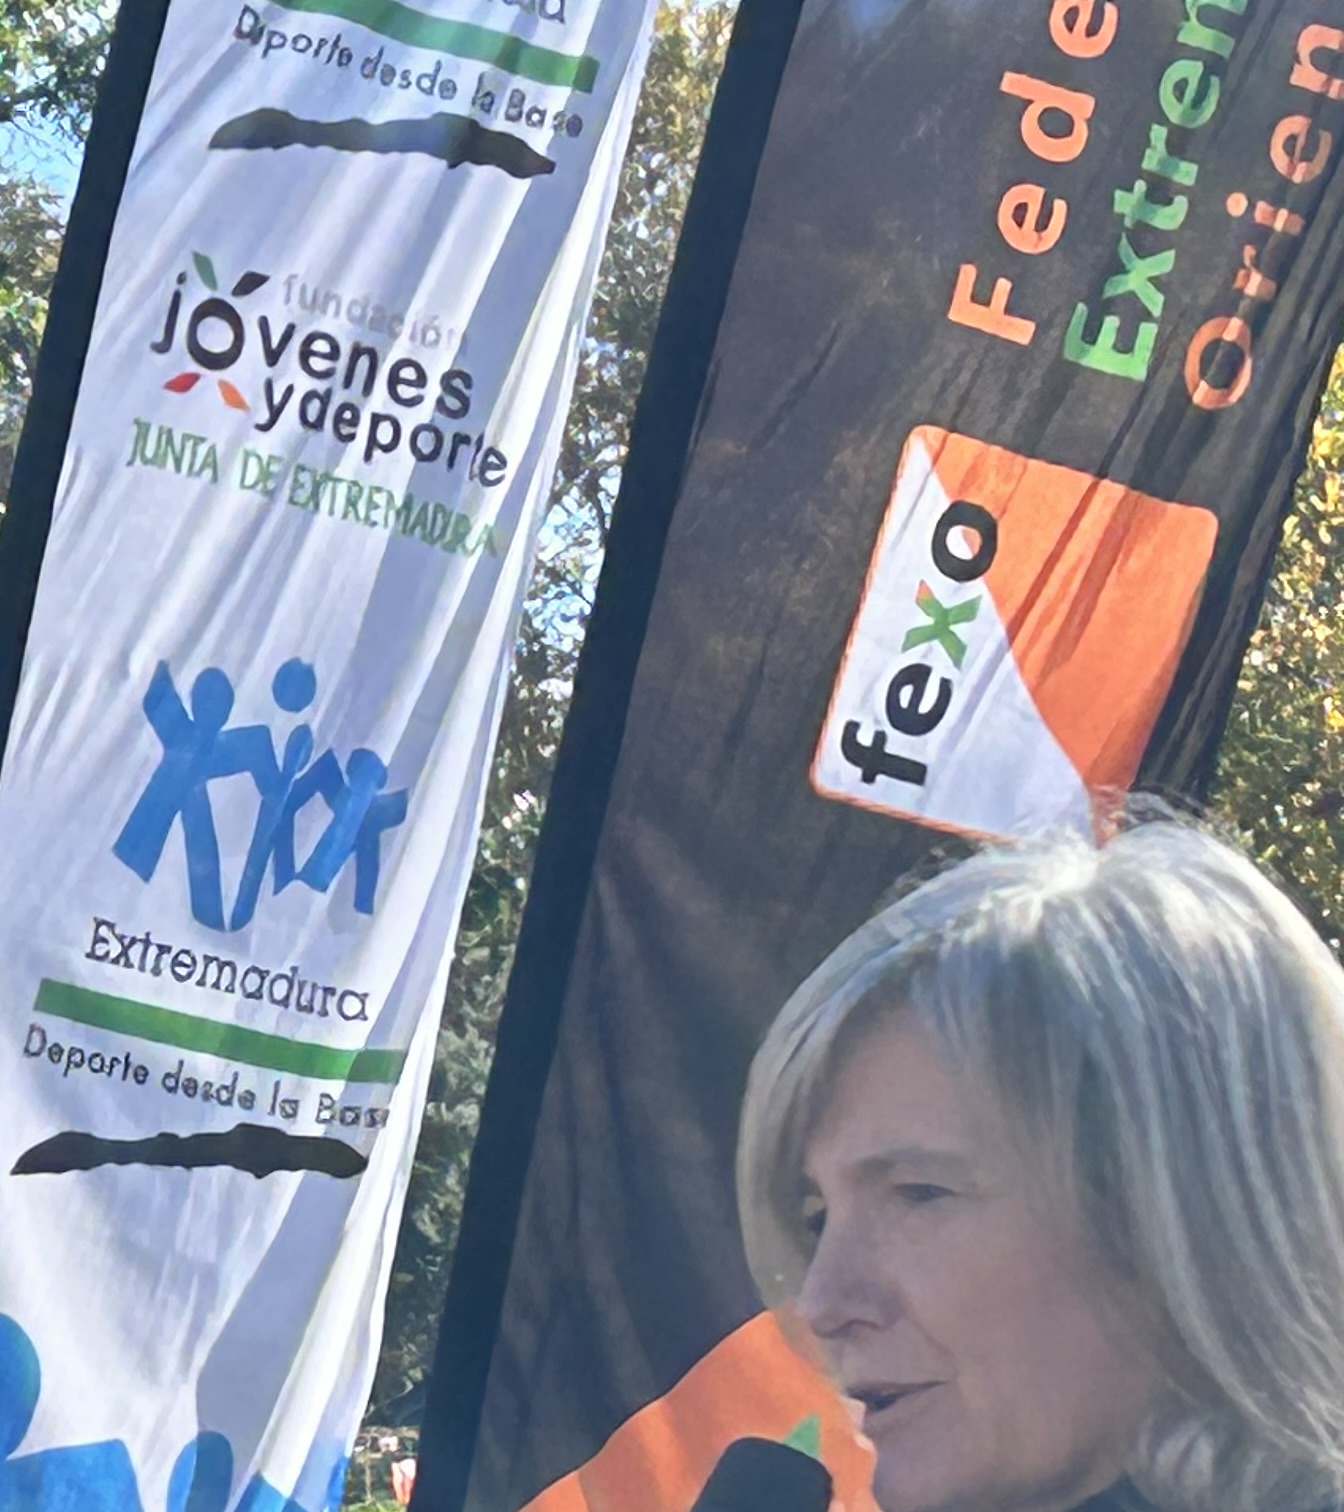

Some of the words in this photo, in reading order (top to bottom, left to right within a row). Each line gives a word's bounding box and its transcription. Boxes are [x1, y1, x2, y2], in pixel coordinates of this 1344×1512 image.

[150, 270, 474, 420] jóvenes
[125, 417, 219, 484] JUNTA
[239, 448, 280, 492] DE
[840, 500, 998, 787] fexo
[84, 917, 369, 1022] Extremadura
[22, 1022, 149, 1086] Deporte
[162, 1060, 256, 1110] desde
[267, 1080, 298, 1121] la
[315, 1092, 390, 1130] Bas
